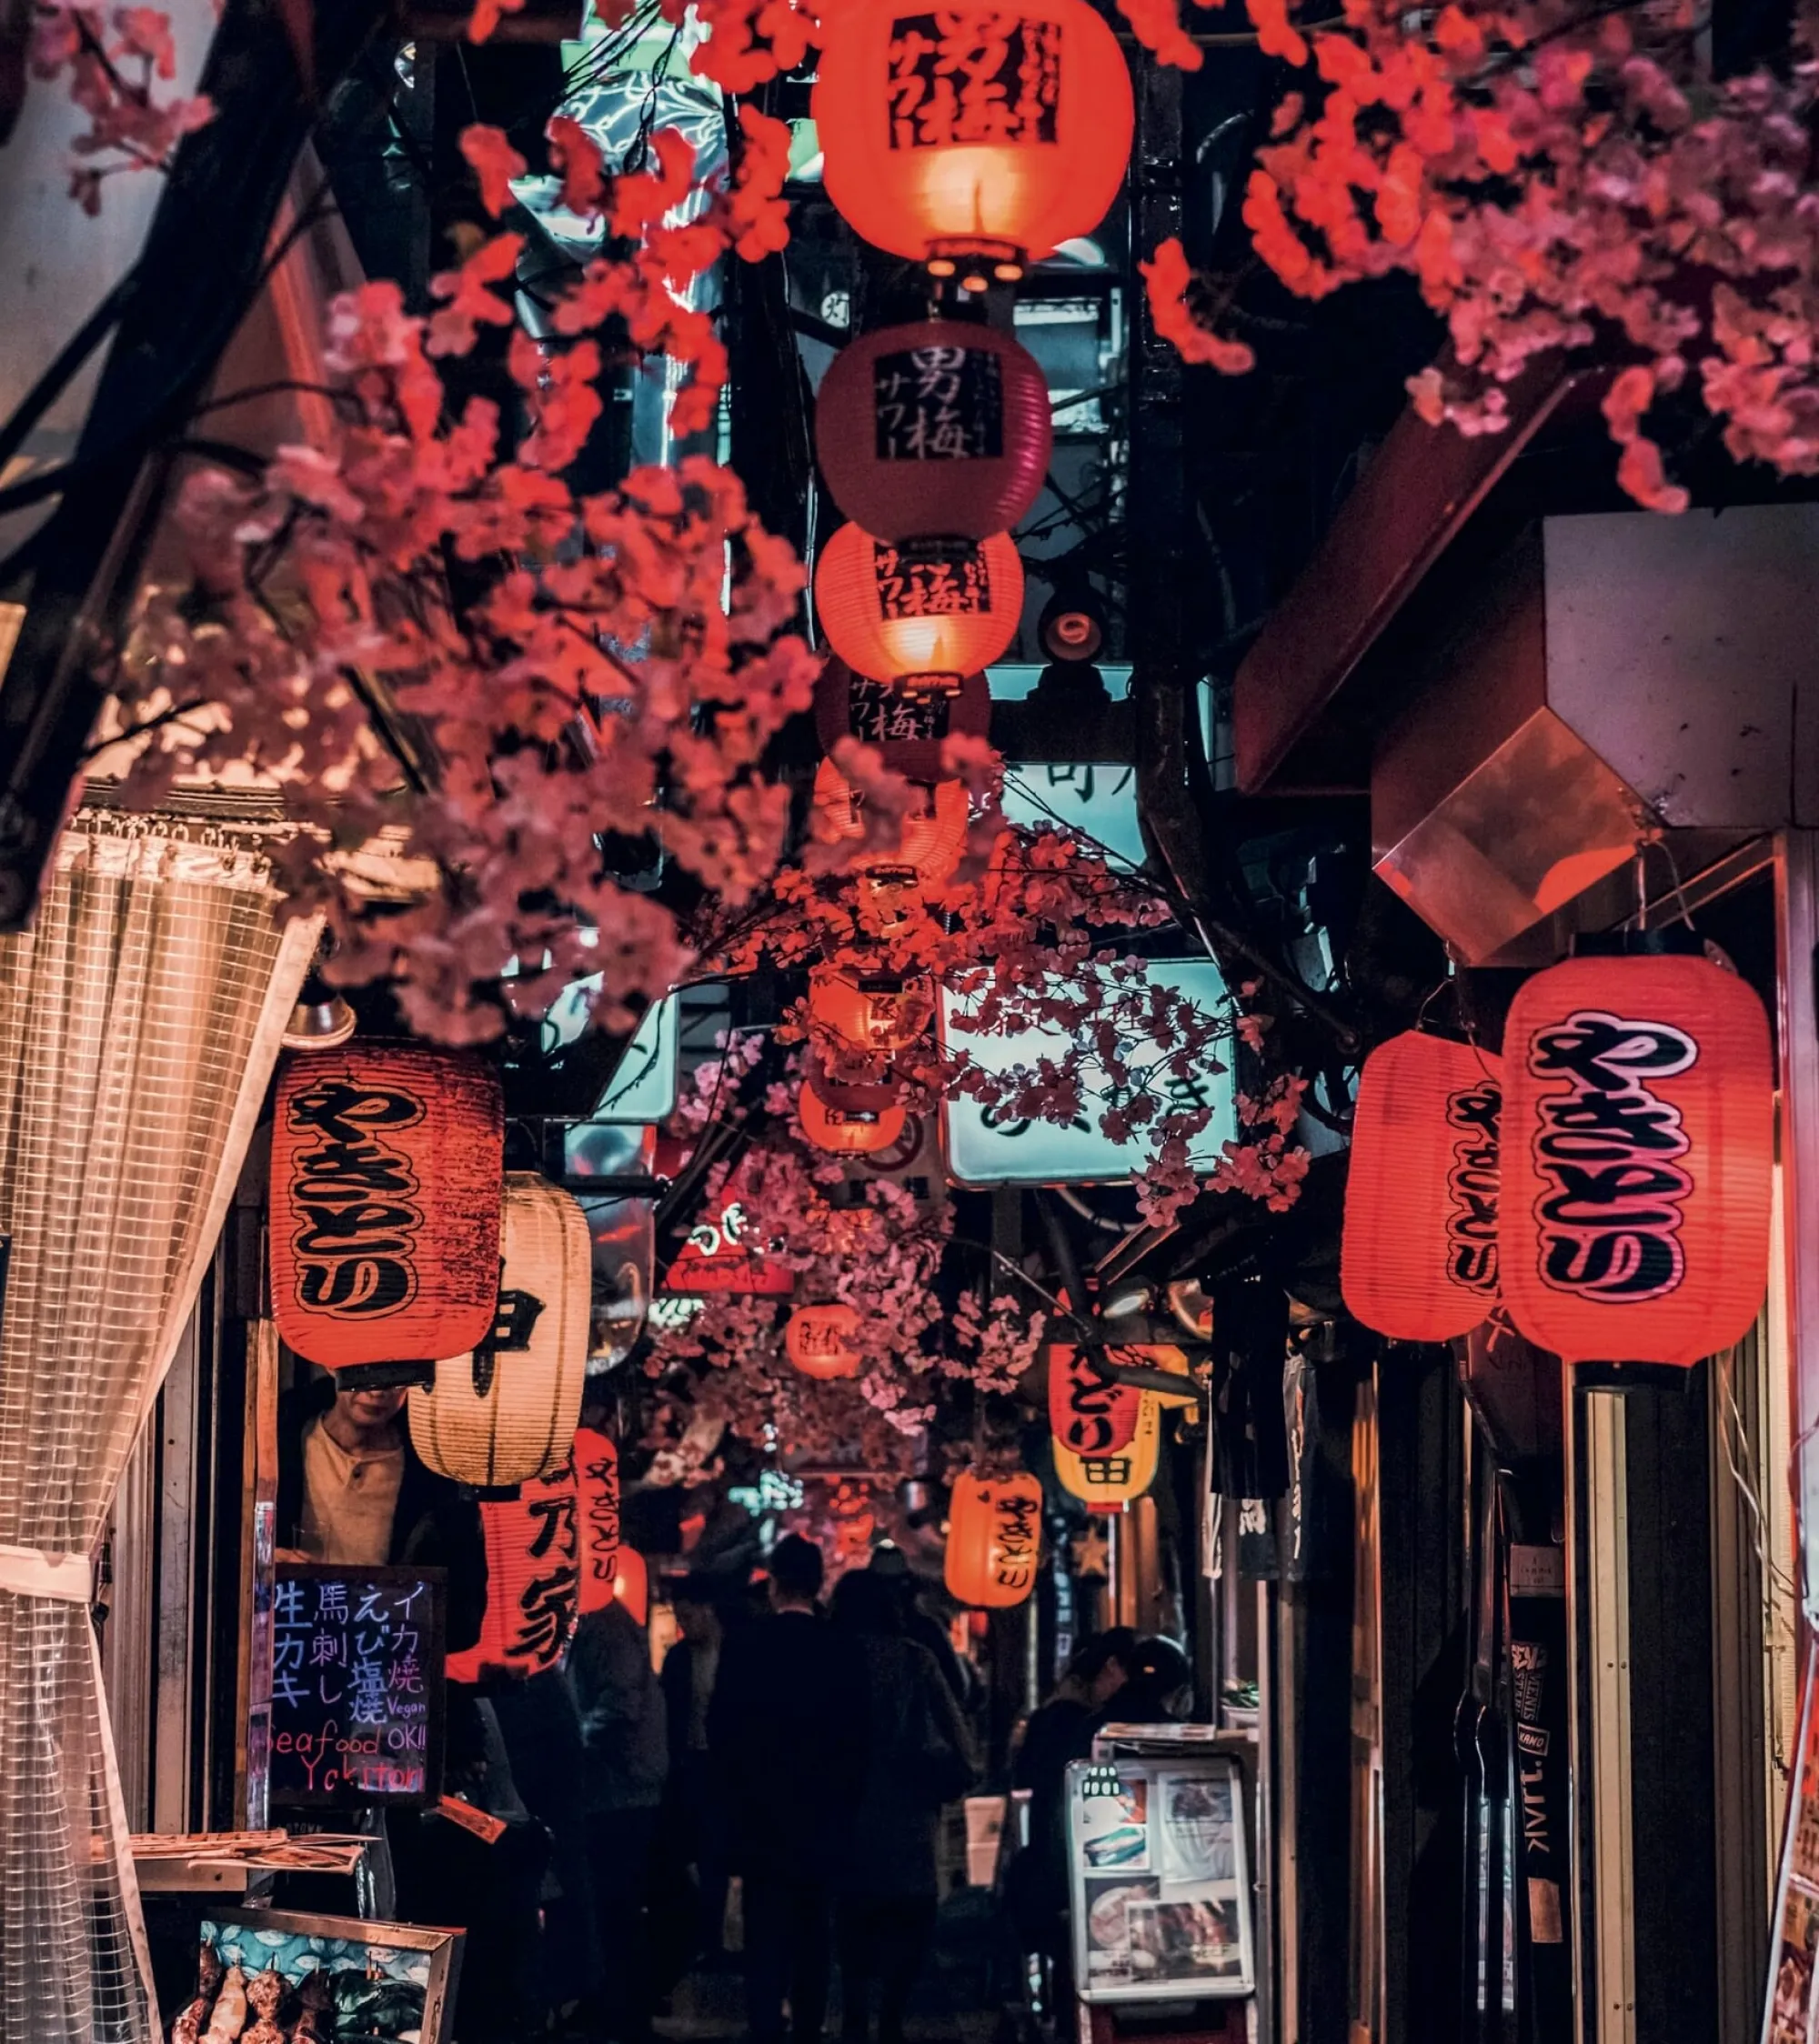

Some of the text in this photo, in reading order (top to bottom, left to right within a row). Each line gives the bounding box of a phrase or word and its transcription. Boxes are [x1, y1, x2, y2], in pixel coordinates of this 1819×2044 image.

[903, 346, 972, 459] 男梅
[288, 1077, 425, 1318] やきとり
[1532, 1013, 1695, 1300] やきとり
[585, 1457, 618, 1583] やきとり
[273, 1580, 314, 1709] 生カキ
[308, 1584, 348, 1705] 馬刺し
[267, 1718, 381, 1754] eafood
[387, 1697, 427, 1719] Vegan
[387, 1726, 427, 1751] OK!!
